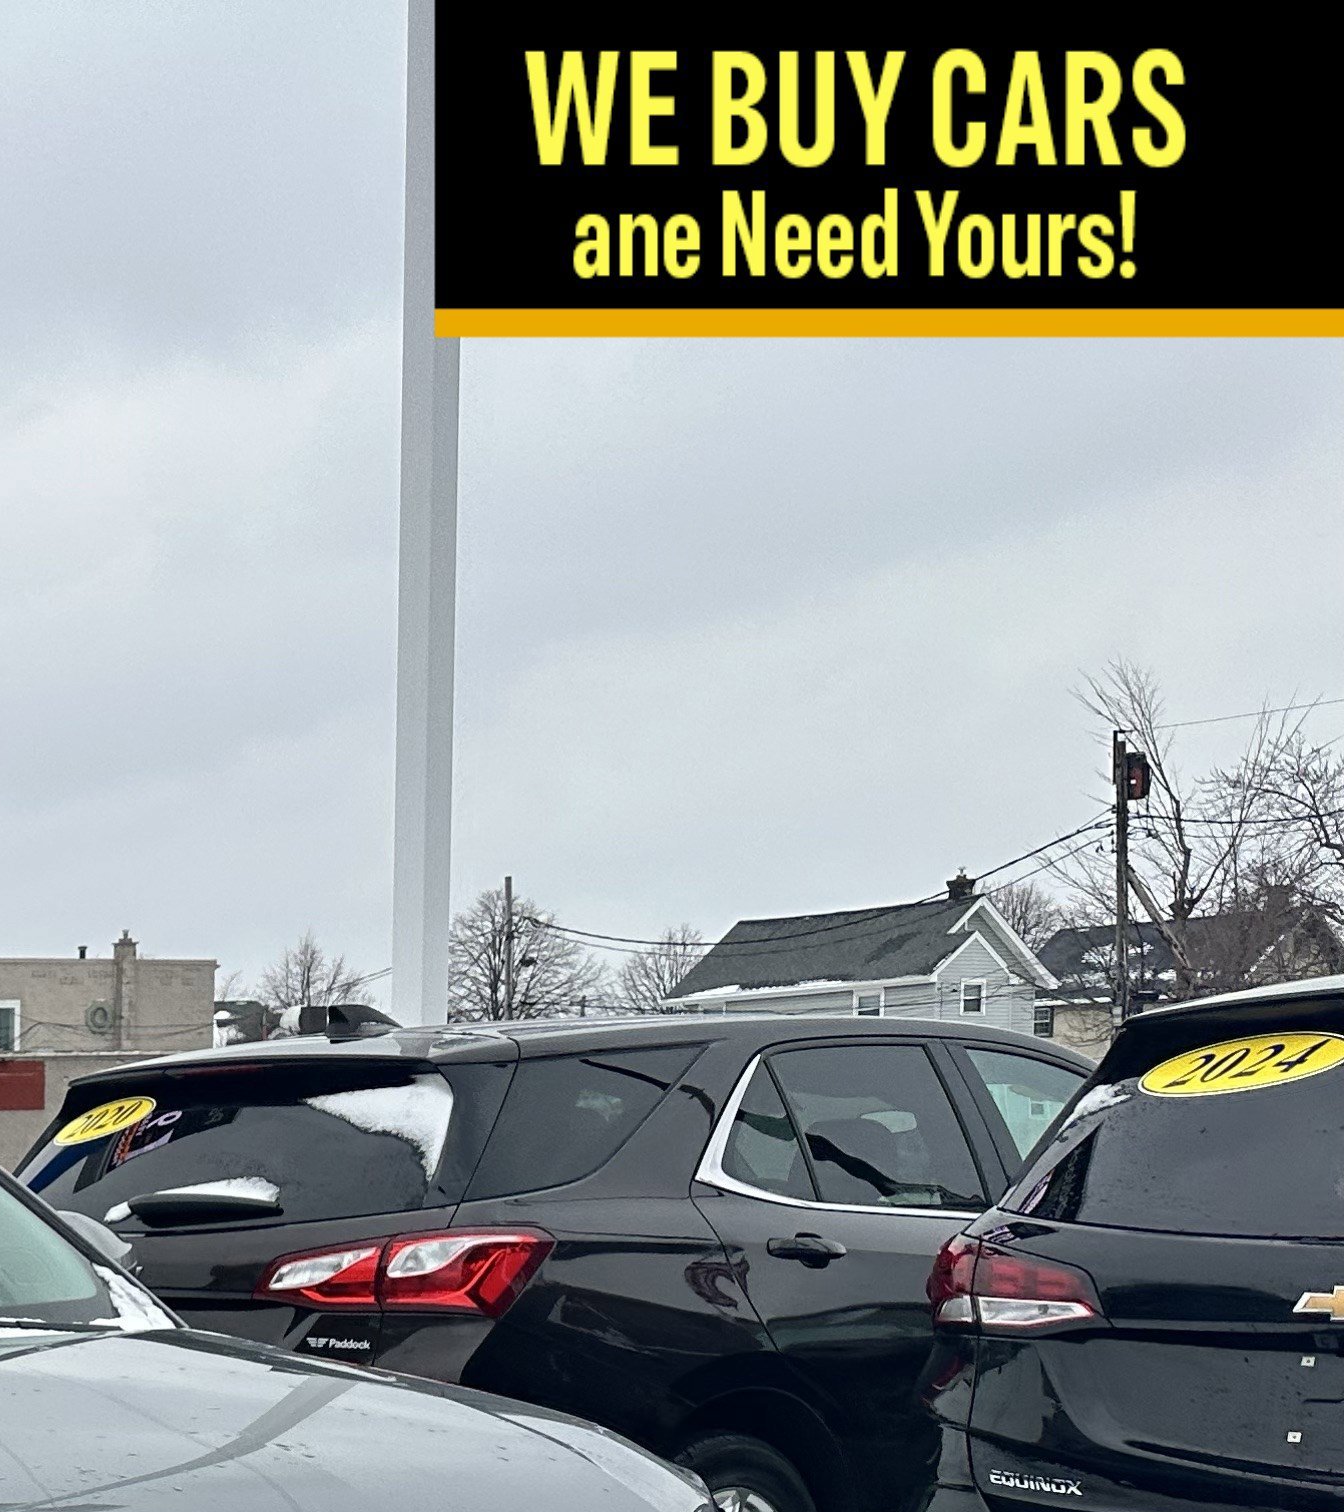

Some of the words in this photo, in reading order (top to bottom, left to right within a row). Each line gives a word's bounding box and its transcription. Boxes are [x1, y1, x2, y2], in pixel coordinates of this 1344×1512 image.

[1162, 1038, 1332, 1089] 2024
[66, 1100, 143, 1139] 2020
[328, 1338, 371, 1350] Paddock
[989, 1469, 1083, 1496] EQUINOX
